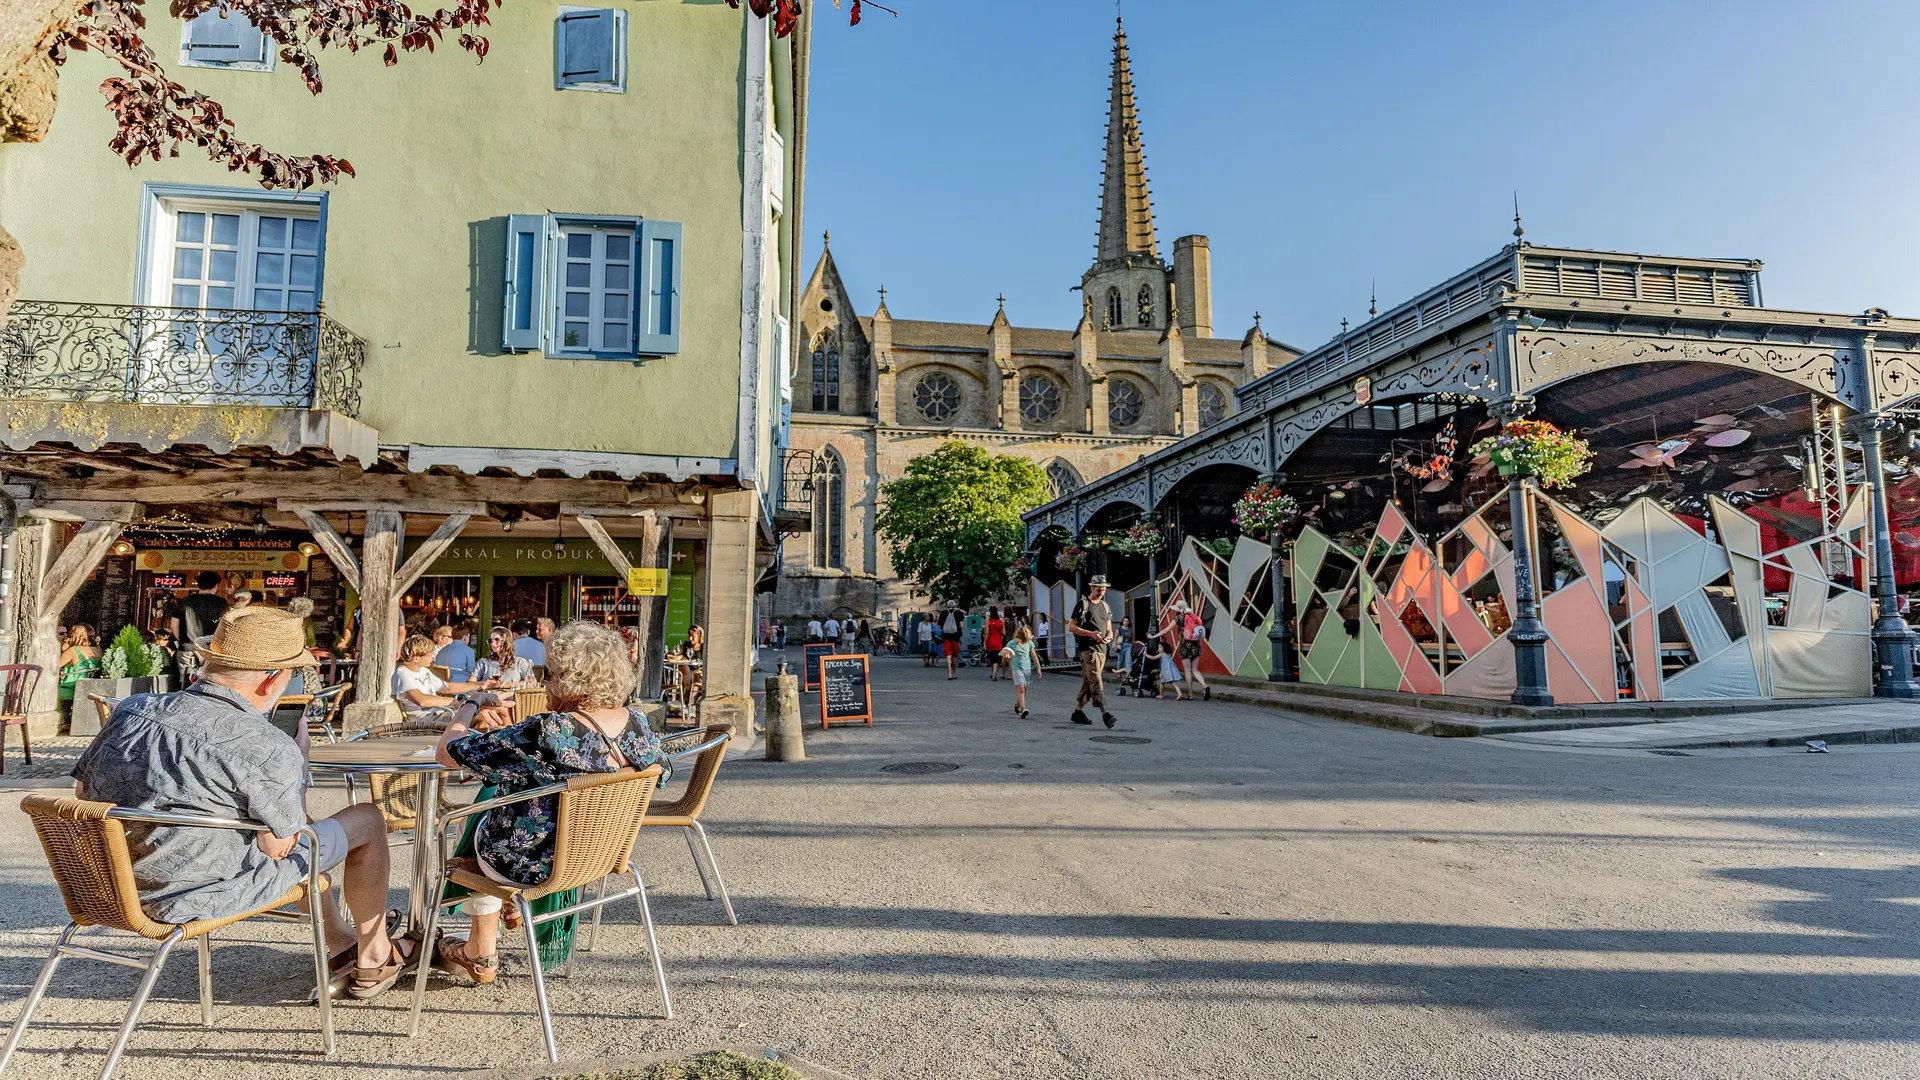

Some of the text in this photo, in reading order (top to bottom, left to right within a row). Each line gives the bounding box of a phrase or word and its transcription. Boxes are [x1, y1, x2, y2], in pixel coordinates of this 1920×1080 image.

[182, 551, 200, 561] LE
[440, 548, 500, 558] USKAL
[154, 577, 183, 586] PIZZA
